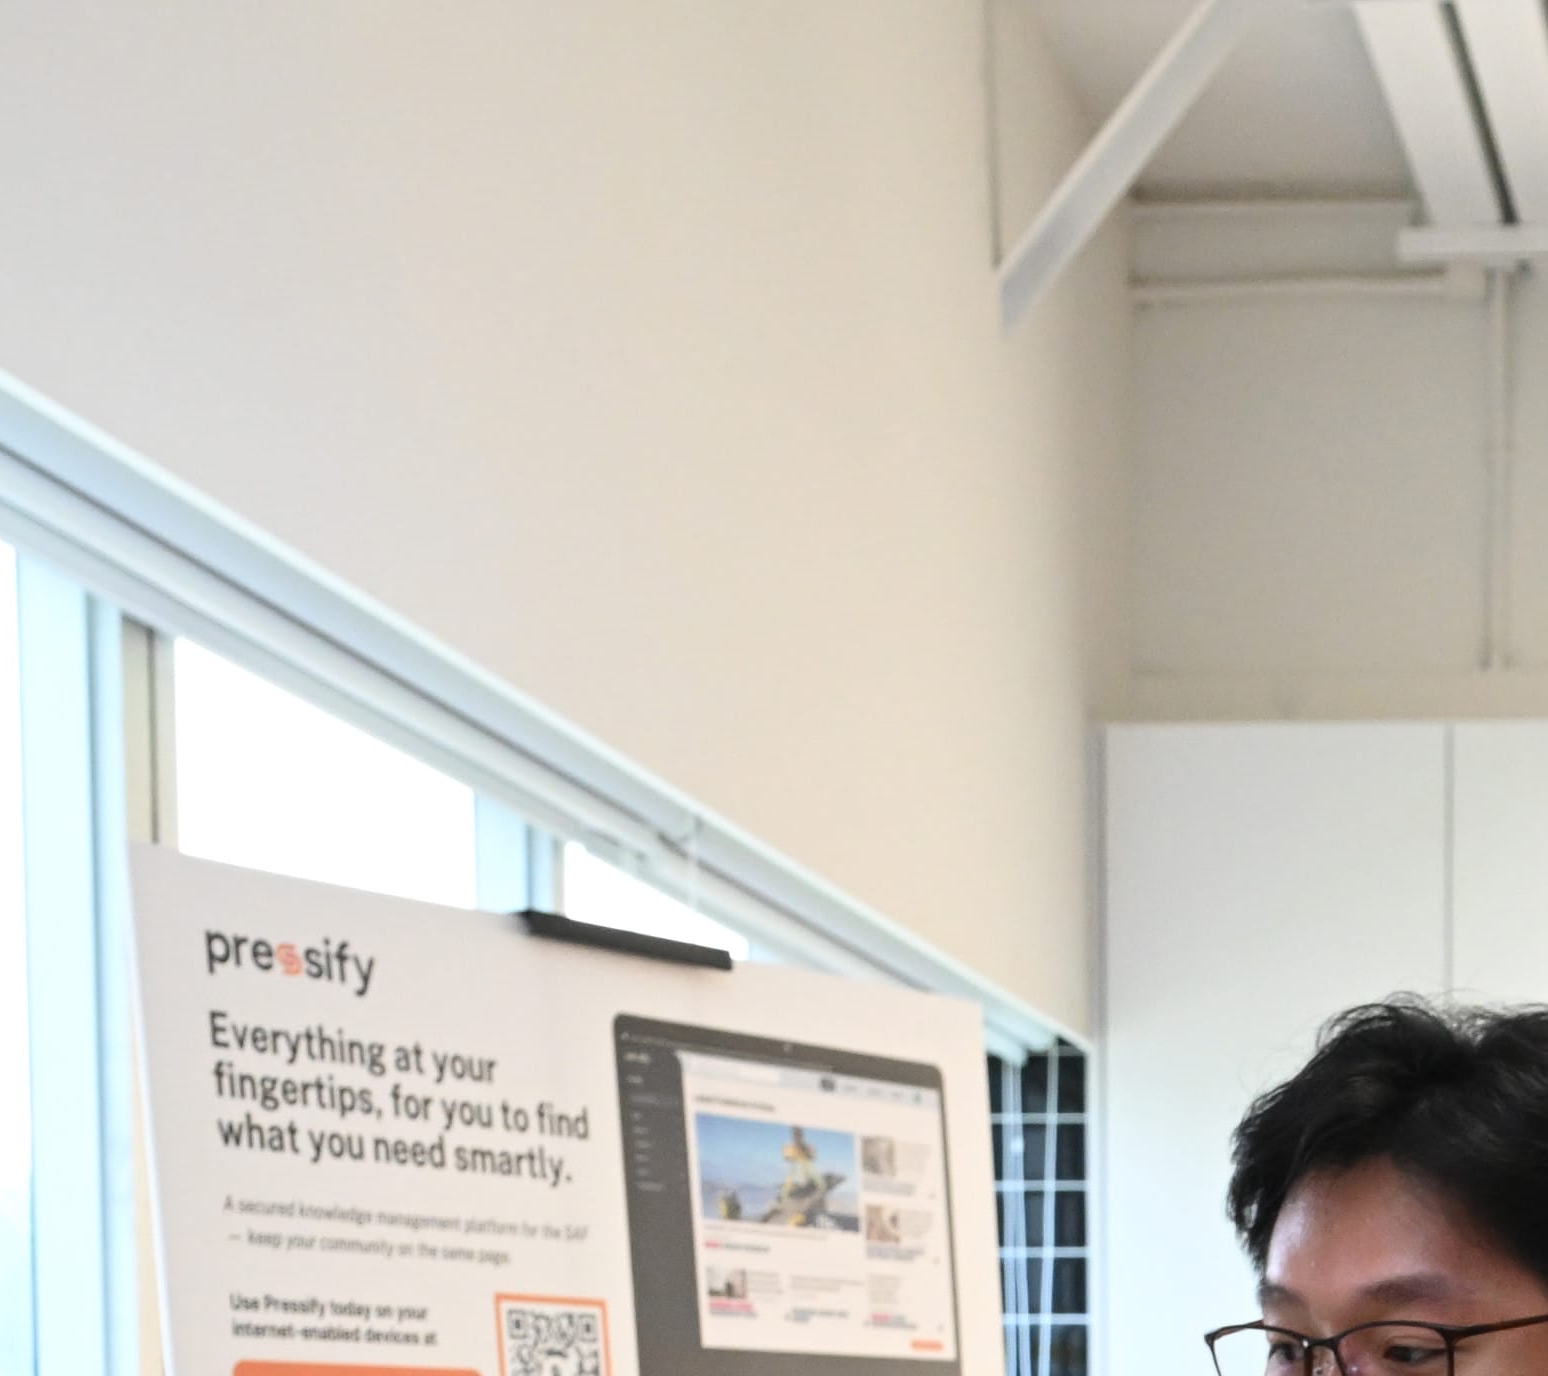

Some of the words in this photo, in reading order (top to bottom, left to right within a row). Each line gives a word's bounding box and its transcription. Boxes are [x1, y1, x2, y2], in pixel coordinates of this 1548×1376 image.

[205, 929, 375, 997] pressify
[209, 1012, 386, 1075] Everything
[394, 1043, 424, 1072] at
[433, 1055, 496, 1082] your
[213, 1059, 382, 1118] fingertips,
[390, 1084, 432, 1120] for
[438, 1101, 493, 1132] you
[500, 1103, 529, 1132] to
[536, 1104, 589, 1139] find
[218, 1113, 299, 1152] what
[309, 1133, 365, 1162] you
[373, 1137, 446, 1168] need
[454, 1148, 572, 1185] smartly.
[230, 1294, 260, 1310] Use
[263, 1296, 325, 1316] Pressify
[329, 1302, 371, 1319] today
[375, 1306, 393, 1318] on
[397, 1308, 428, 1321] your
[232, 1324, 361, 1341] internet-enabled
[365, 1329, 420, 1344] devices
[423, 1333, 437, 1345] at
